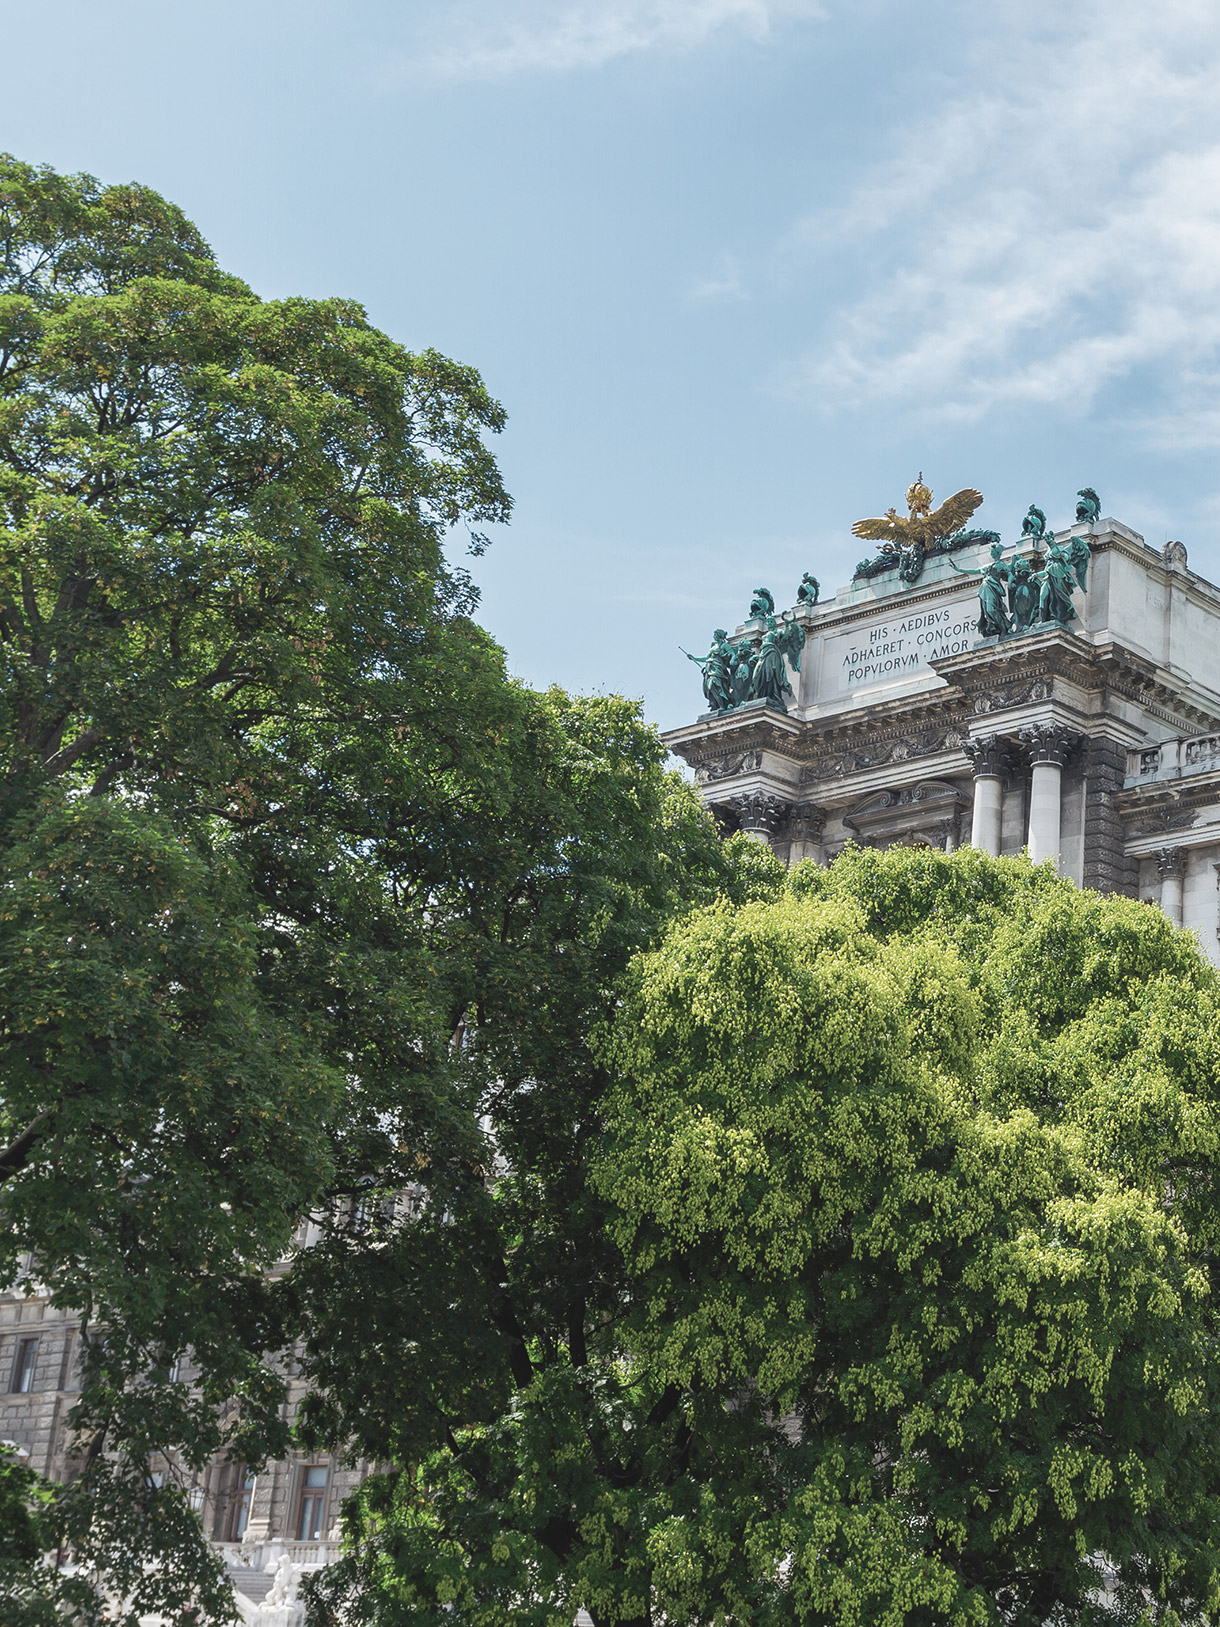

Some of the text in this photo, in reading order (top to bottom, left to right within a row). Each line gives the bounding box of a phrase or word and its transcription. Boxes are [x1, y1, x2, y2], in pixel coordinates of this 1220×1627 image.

[843, 619, 977, 666] ADHAERET CONCORS
[870, 610, 950, 642] HIS AEDIBVS
[848, 639, 969, 682] POPVLORVM AMOR
